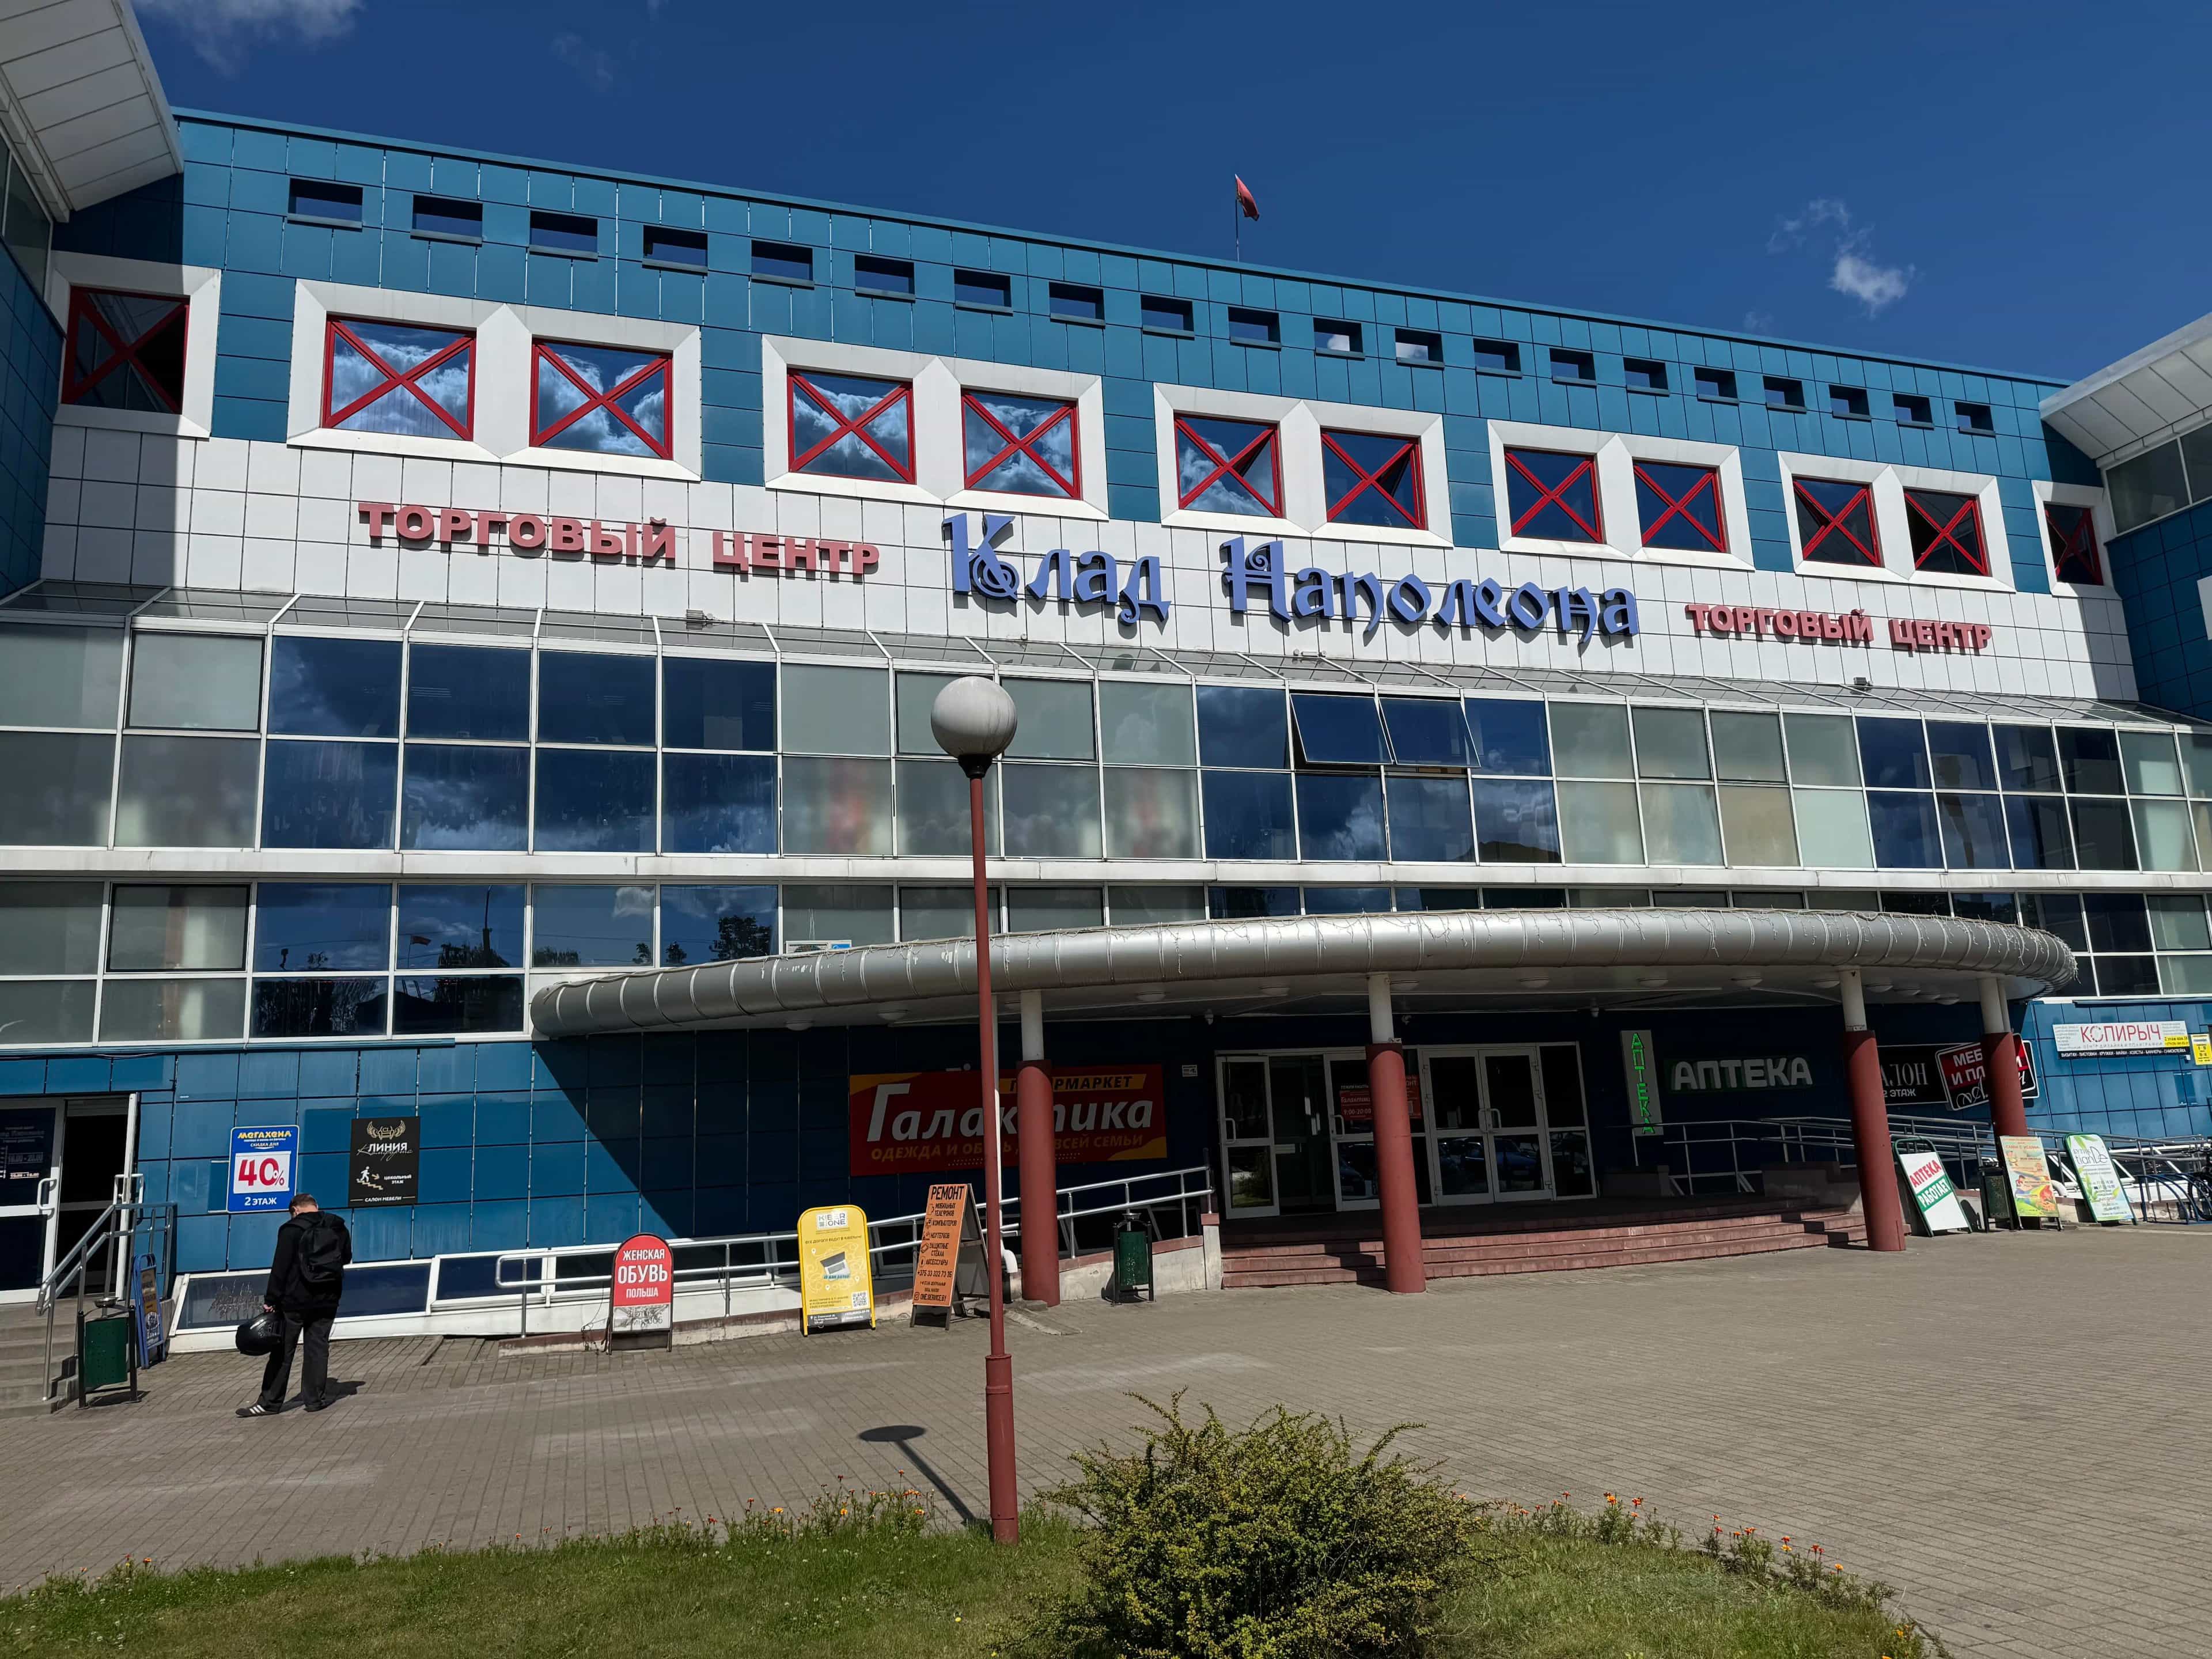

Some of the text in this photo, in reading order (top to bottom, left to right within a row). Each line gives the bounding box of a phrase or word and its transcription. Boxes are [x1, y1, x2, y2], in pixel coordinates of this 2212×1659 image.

[358, 502, 879, 574] ТОРГОВЫЙ ЦЕНТР
[942, 513, 1639, 647] Клад Наполеона
[1685, 604, 1992, 650] ТОРГОВЫЙ ЦЕНТР
[2080, 1024, 2161, 1043] КОПИРЫЧ
[1009, 1074, 1133, 1092] ГРМАРКЕТ
[1631, 1033, 1656, 1134] АПТЕКА
[1673, 1056, 1813, 1091] АПТЕКА
[1889, 1088, 1916, 1097] ЭТАЖ
[368, 1142, 408, 1153] ЛИНИЯ
[870, 1144, 941, 1162] ОДЕЖДА
[963, 1140, 1013, 1156] ОБЬ
[1094, 1134, 1143, 1148] СЕМЬИ
[1910, 1160, 1942, 1188] АПТЕКА
[244, 1197, 277, 1206] 2 ЭТАЖ
[931, 1185, 965, 1200] РЕМОНТ
[1917, 1178, 1952, 1208] РАБОТАЕТ
[623, 1248, 665, 1262] ЖЕНСКАЯ
[618, 1264, 668, 1285] ОБУВЬ
[626, 1287, 659, 1298] ПОЛЬША
